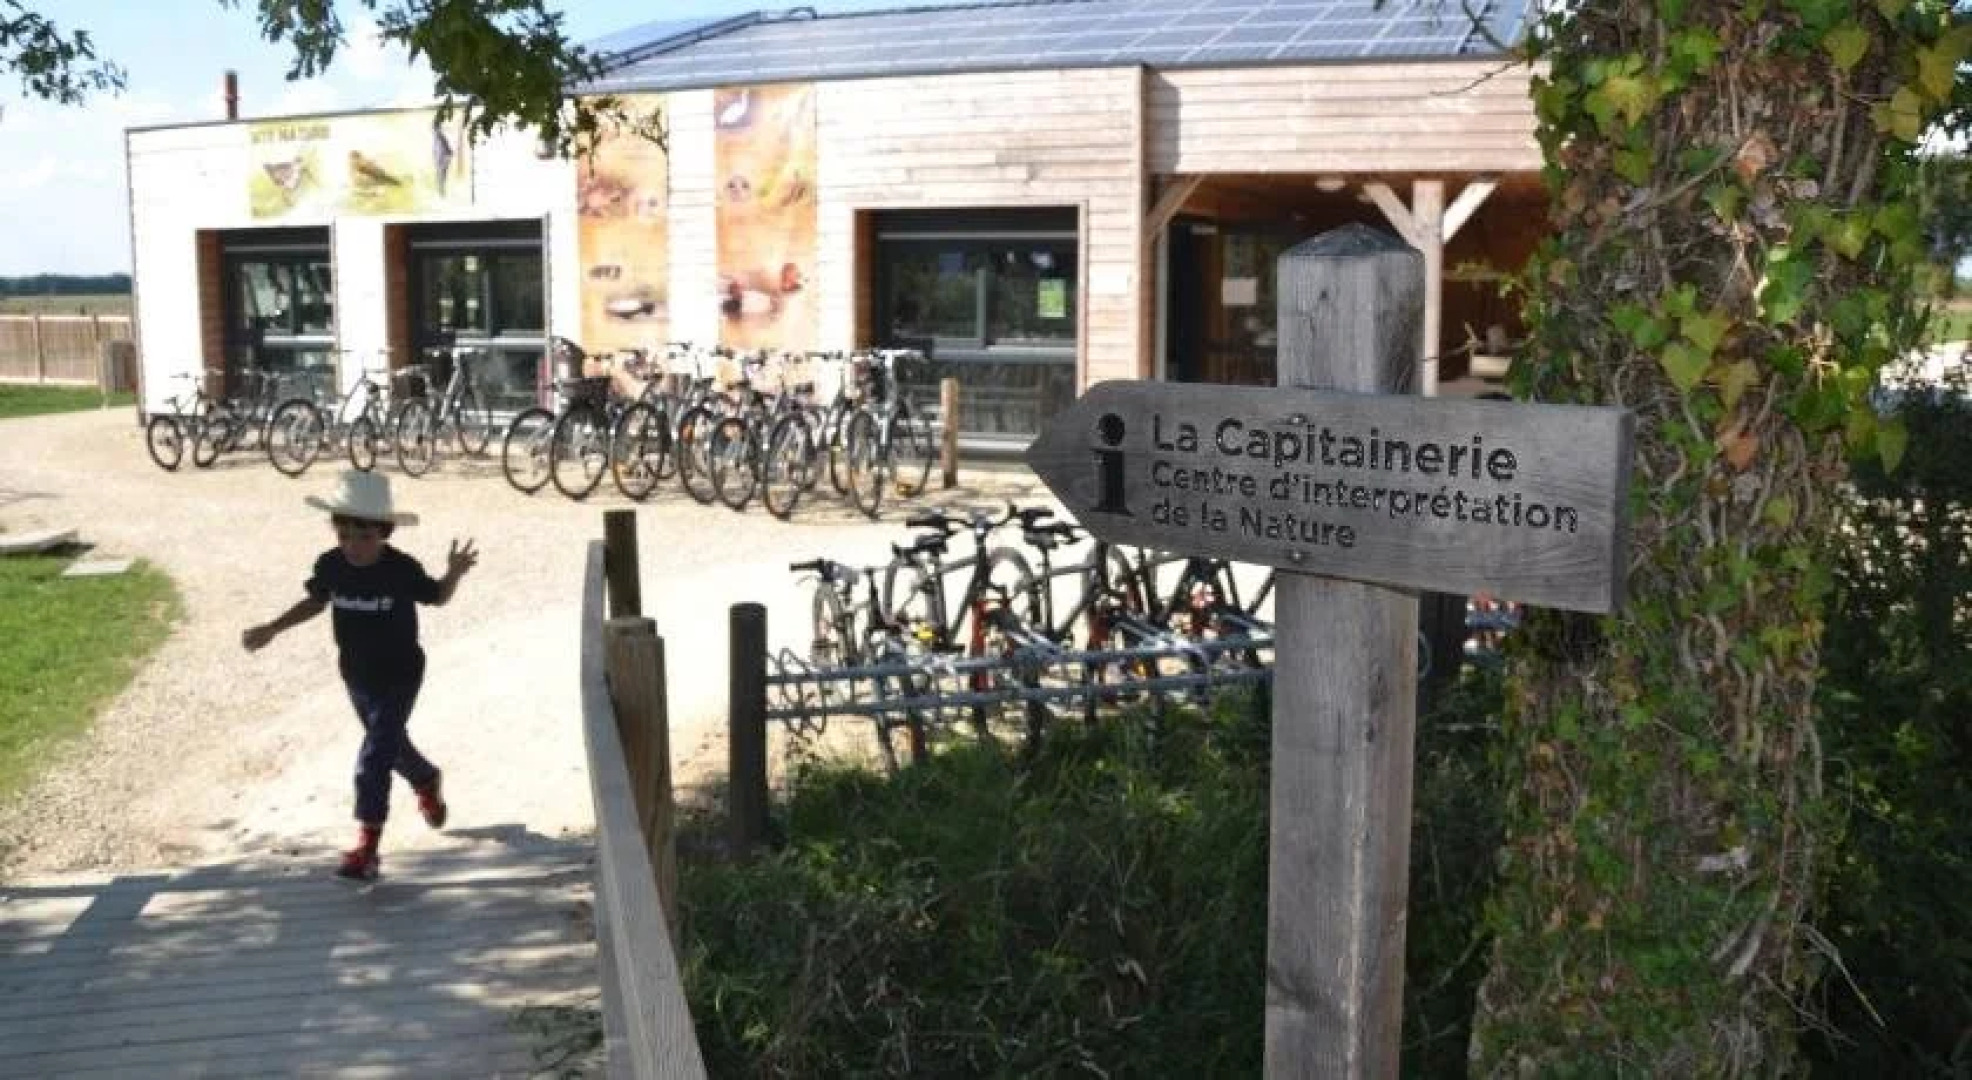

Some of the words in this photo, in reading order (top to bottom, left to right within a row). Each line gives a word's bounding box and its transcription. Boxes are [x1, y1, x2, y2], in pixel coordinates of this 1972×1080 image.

[1154, 414, 1198, 452] La
[1216, 418, 1518, 480] Capitainerie
[1153, 460, 1256, 496] Centre
[1269, 471, 1578, 533] d'interprétation
[1153, 499, 1189, 526] de
[1201, 502, 1228, 531] la
[1240, 506, 1356, 547] Nature
